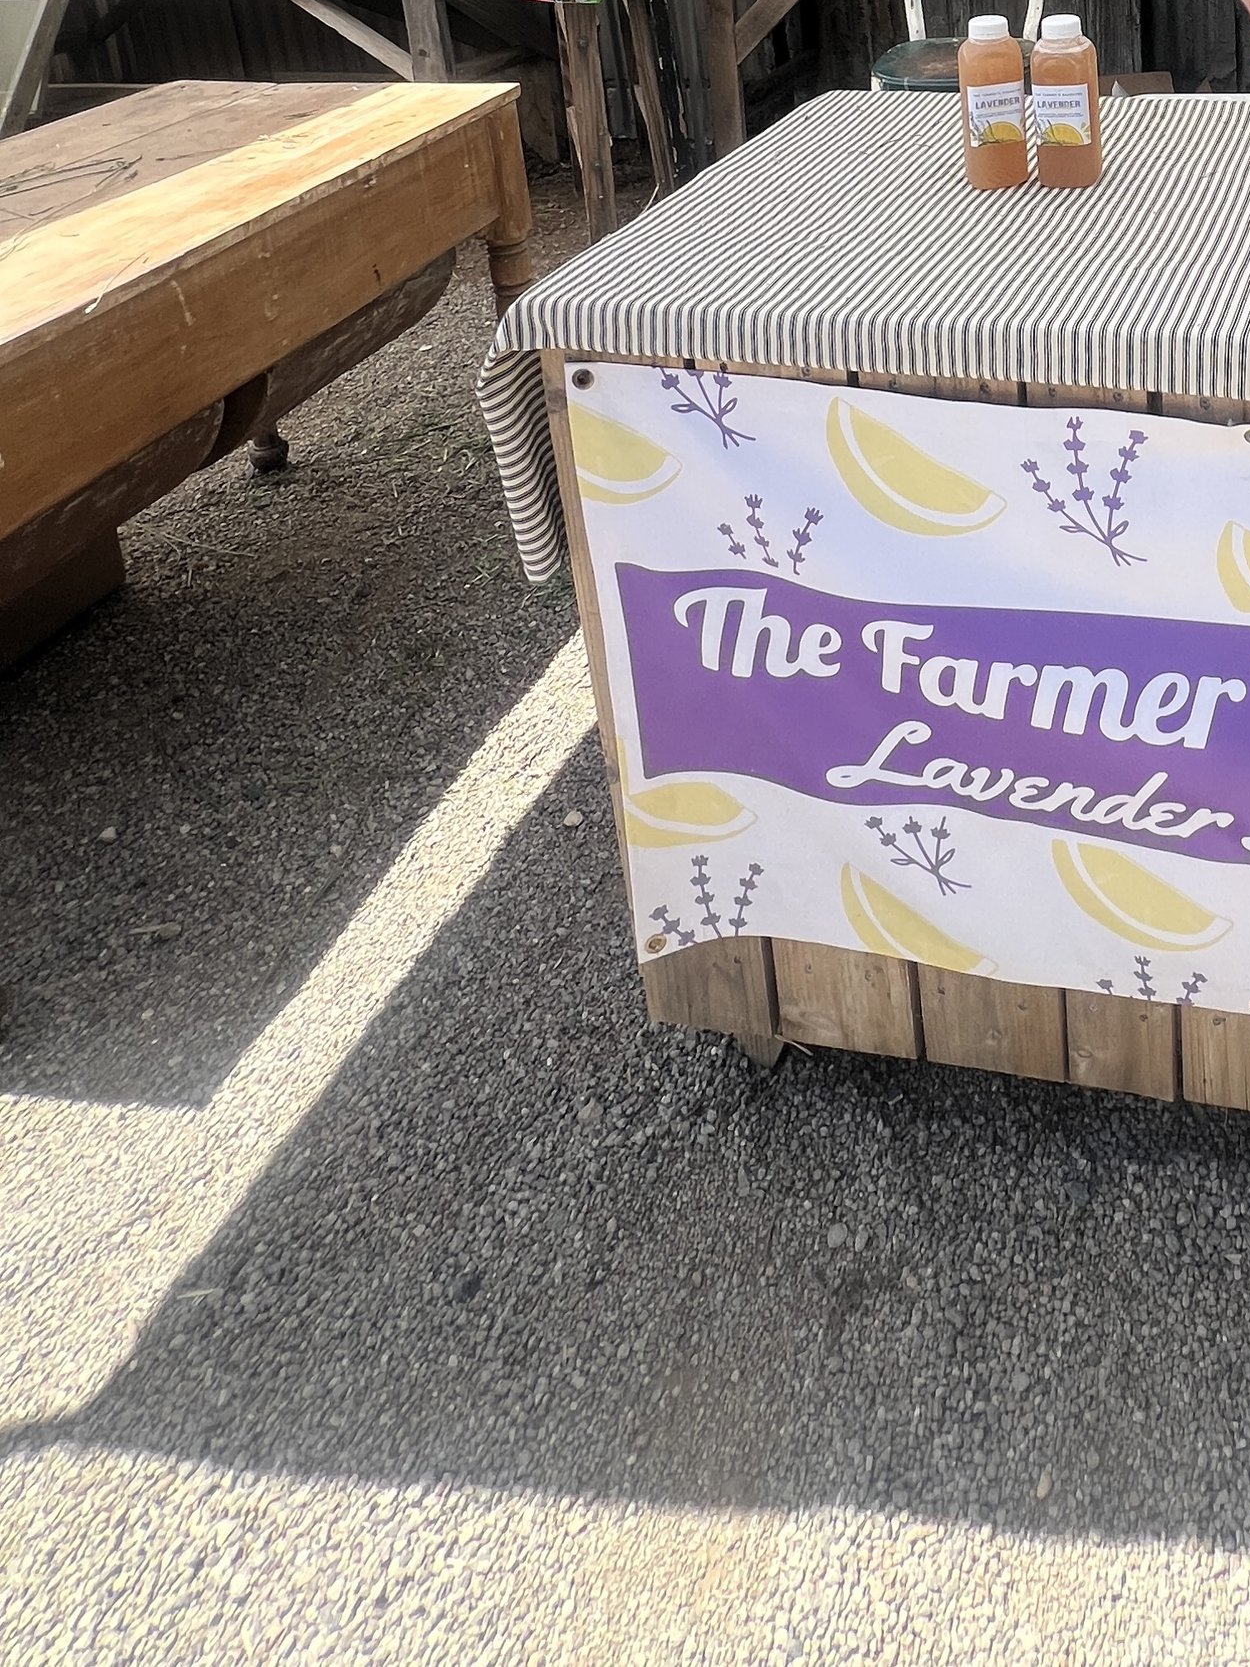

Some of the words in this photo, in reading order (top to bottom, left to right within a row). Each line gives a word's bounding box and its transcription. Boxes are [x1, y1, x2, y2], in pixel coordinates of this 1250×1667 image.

[975, 96, 1020, 110] LAVENDER
[1036, 100, 1081, 108] LAVENDER
[673, 586, 843, 680] The
[824, 719, 1235, 840] Lavender
